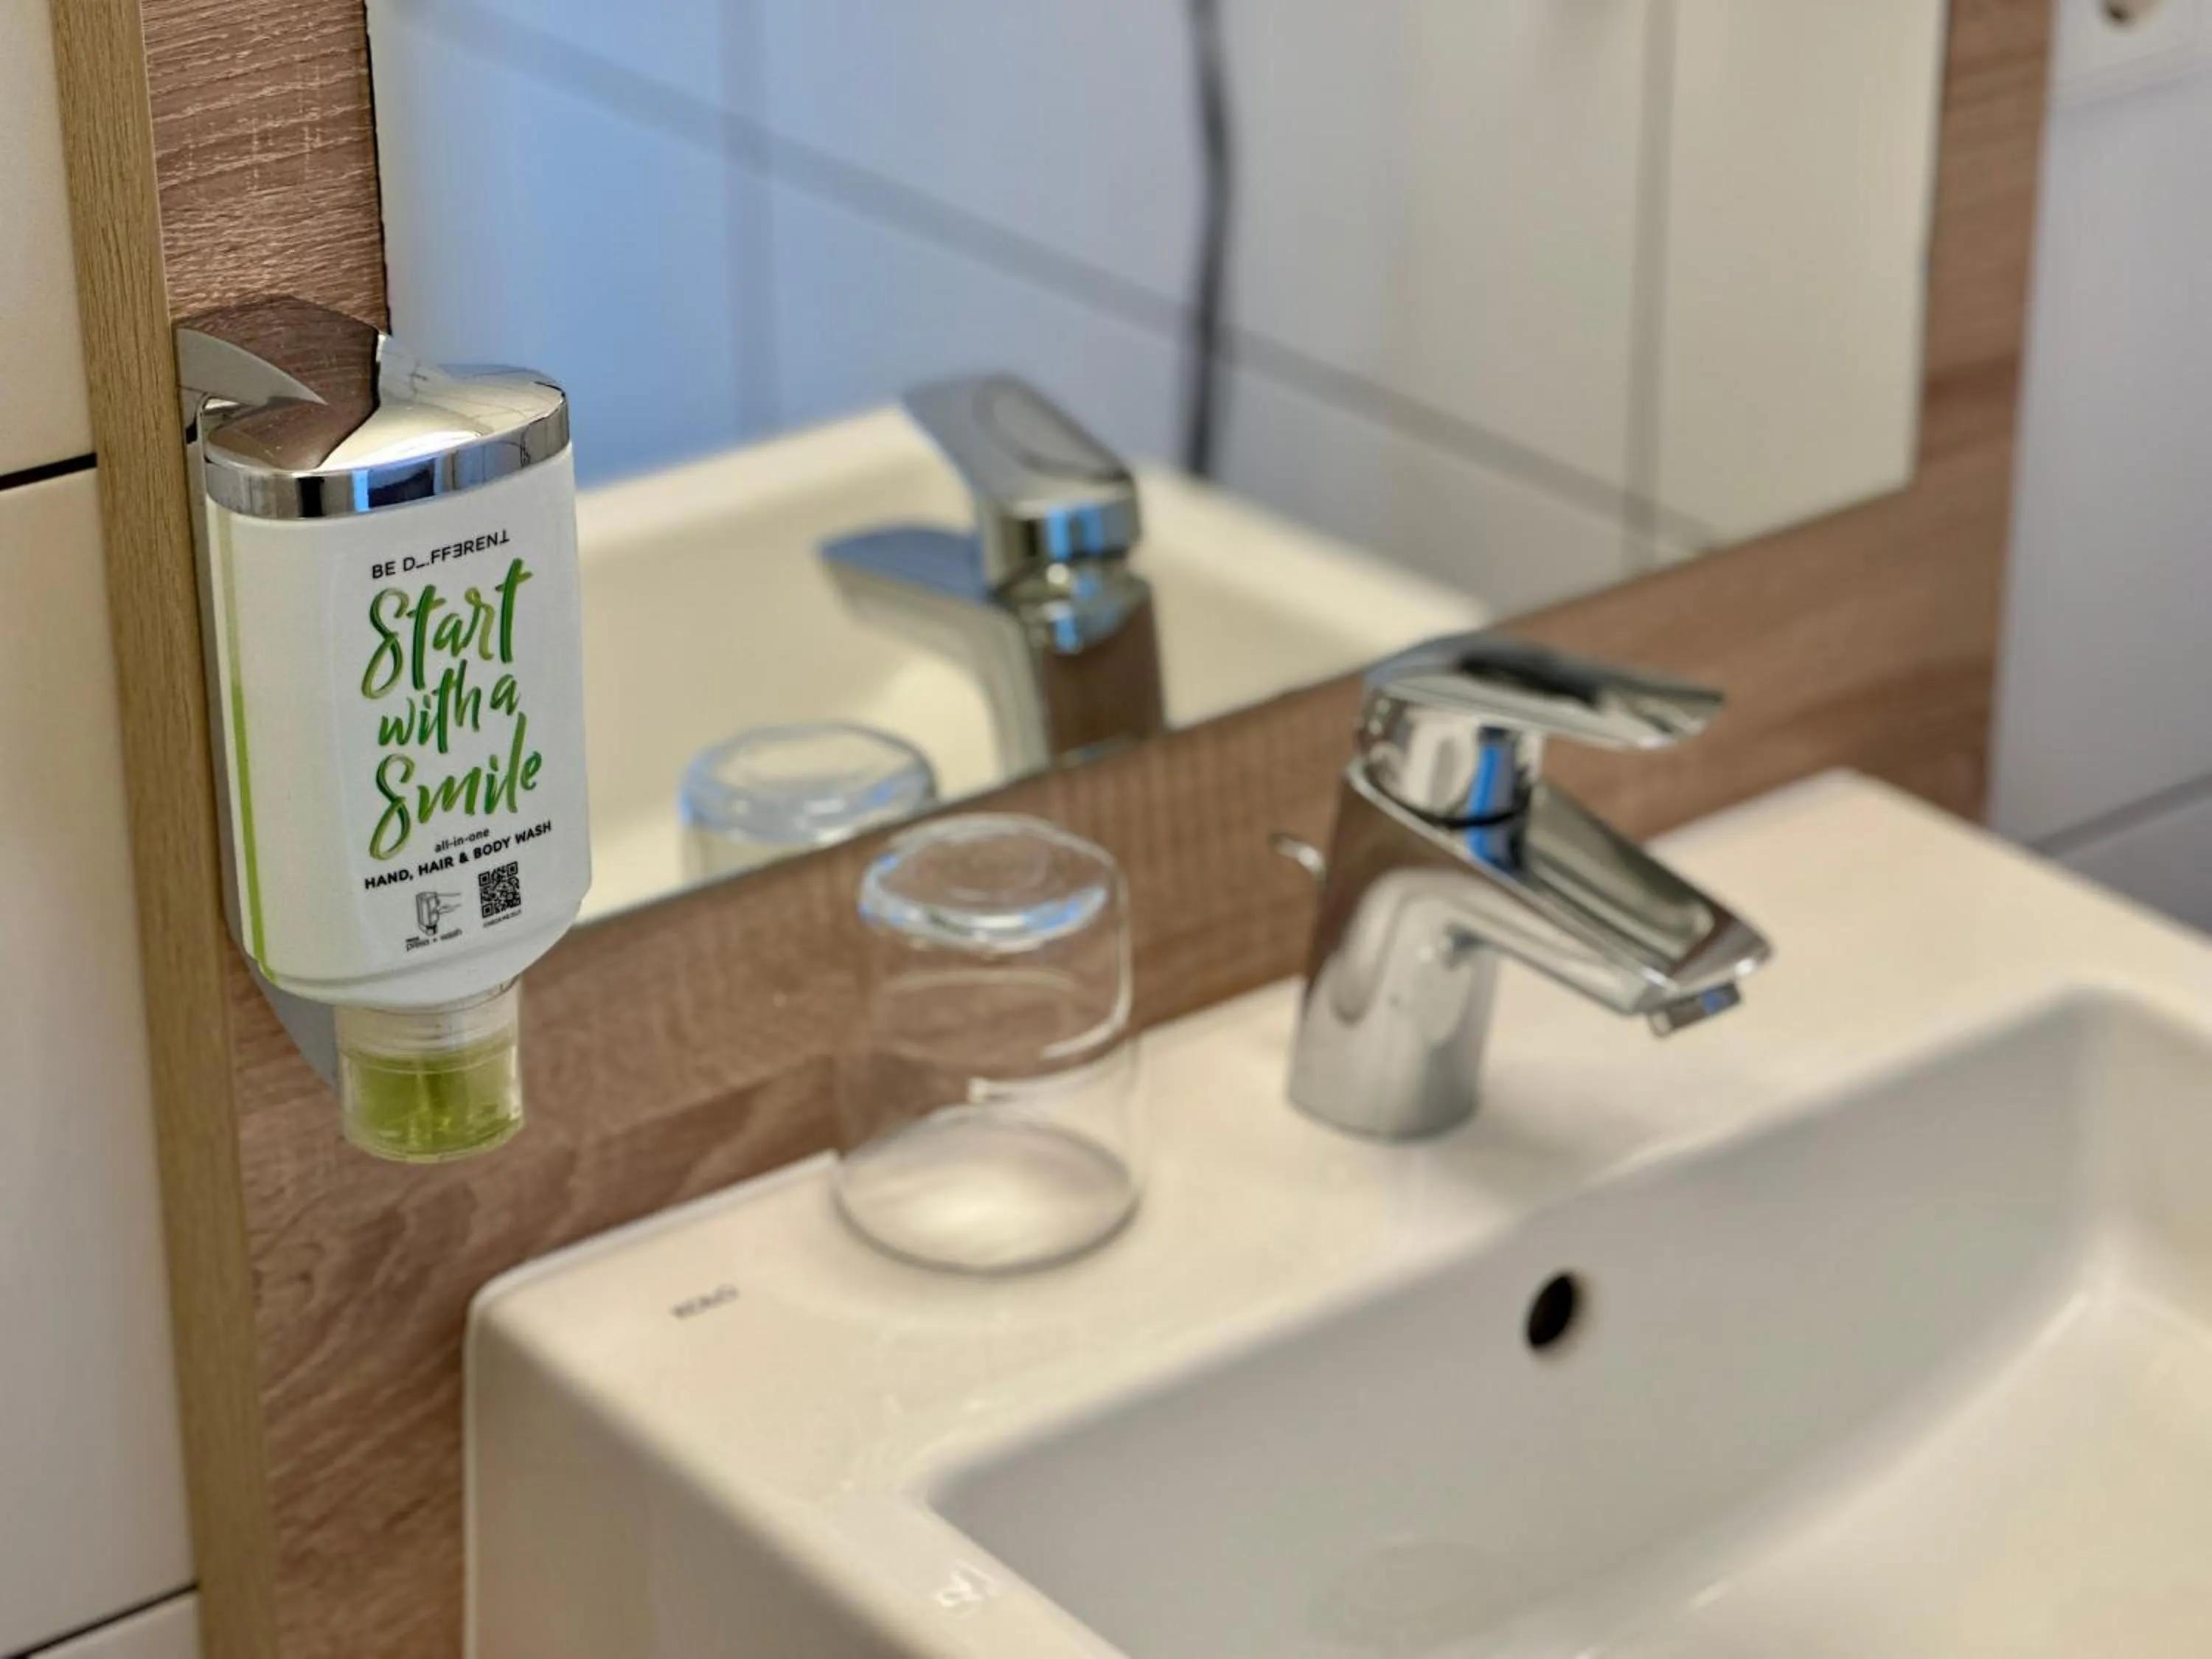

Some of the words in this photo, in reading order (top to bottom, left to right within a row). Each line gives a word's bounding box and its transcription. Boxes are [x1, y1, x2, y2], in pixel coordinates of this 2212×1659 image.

[372, 560, 396, 580] BE
[361, 557, 534, 700] Start
[378, 658, 481, 754] with
[489, 673, 521, 716] a
[369, 712, 543, 861] Smile
[364, 869, 414, 890] HAND,
[418, 857, 454, 876] HAIR
[459, 852, 470, 864] &
[473, 836, 512, 860] BODY
[514, 820, 552, 845] WASH
[434, 828, 490, 853] all-in-one
